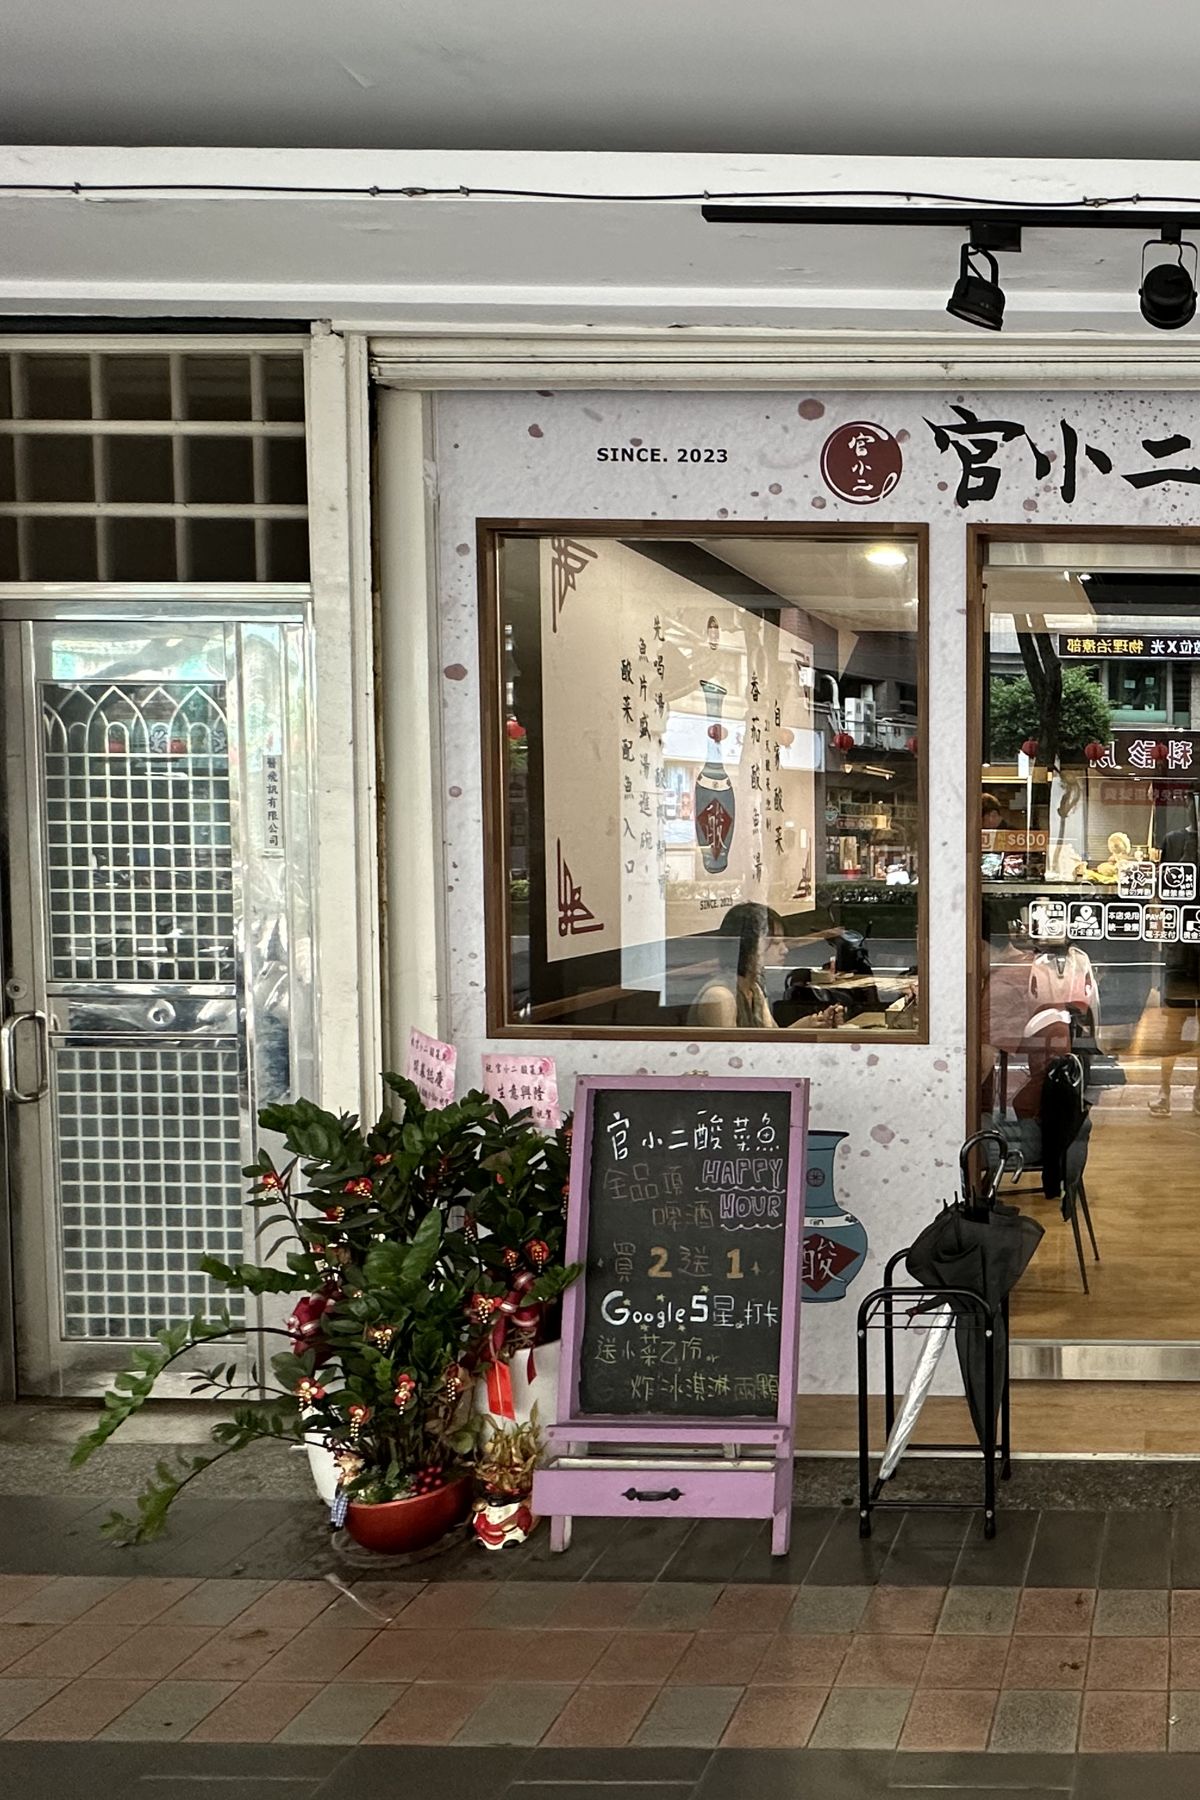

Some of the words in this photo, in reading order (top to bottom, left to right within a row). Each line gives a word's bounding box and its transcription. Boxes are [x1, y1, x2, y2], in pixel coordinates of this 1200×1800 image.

[597, 448, 667, 462] SINCE.
[677, 449, 728, 463] 2023
[1145, 931, 1176, 940] 電子支付
[497, 1085, 545, 1102] 生意興隆
[607, 1111, 779, 1160] 官小二酸菜魚
[602, 1163, 684, 1201] 全品項
[702, 1159, 783, 1189] HAPPY
[719, 1193, 782, 1219] HOUR
